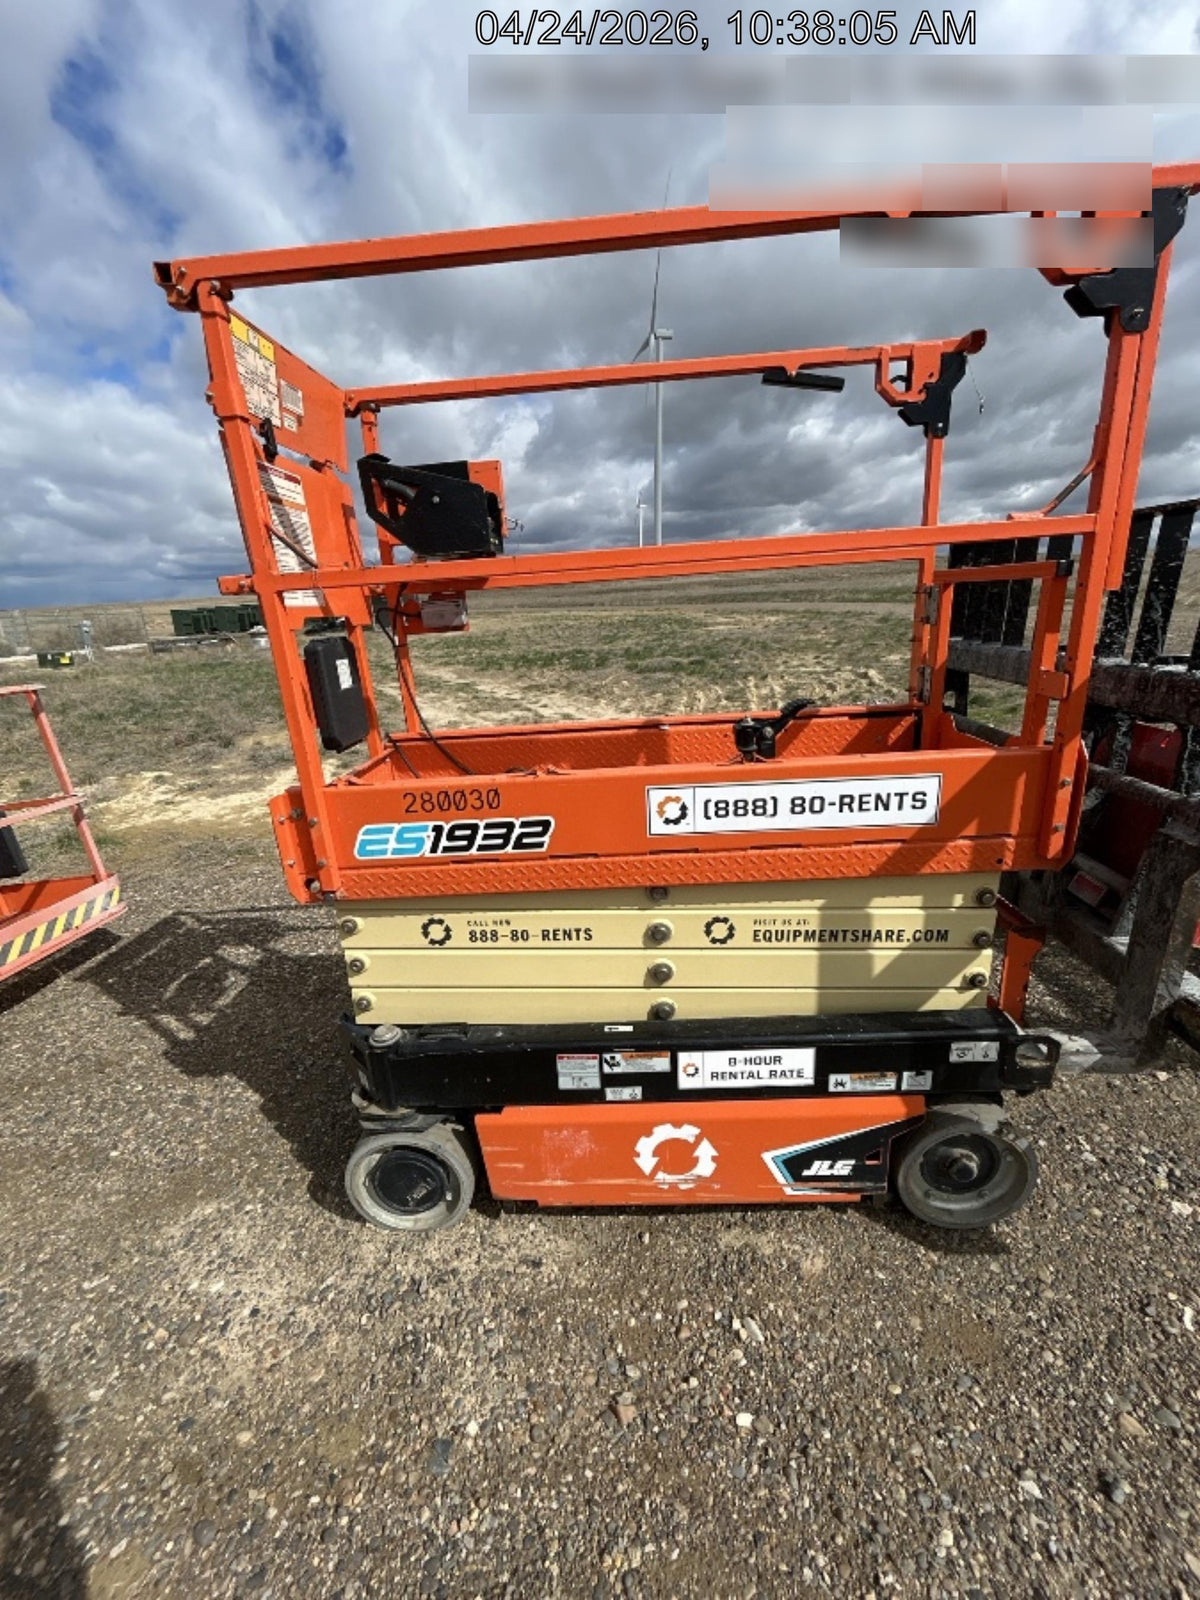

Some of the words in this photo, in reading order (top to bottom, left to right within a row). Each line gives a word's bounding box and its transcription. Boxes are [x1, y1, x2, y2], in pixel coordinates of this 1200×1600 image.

[402, 787, 501, 814] 280030
[703, 796, 778, 820] (888)
[790, 791, 928, 815] 80-RENTS
[356, 818, 553, 858] ES1932
[468, 928, 593, 943] 888-80-RENTS
[752, 929, 950, 943] EQUIPMENTSHARE.COM
[728, 1055, 783, 1067] 8-HOUR
[710, 1071, 764, 1081] RENTAL
[769, 1069, 805, 1080] RATE
[801, 1160, 856, 1176] JLG
